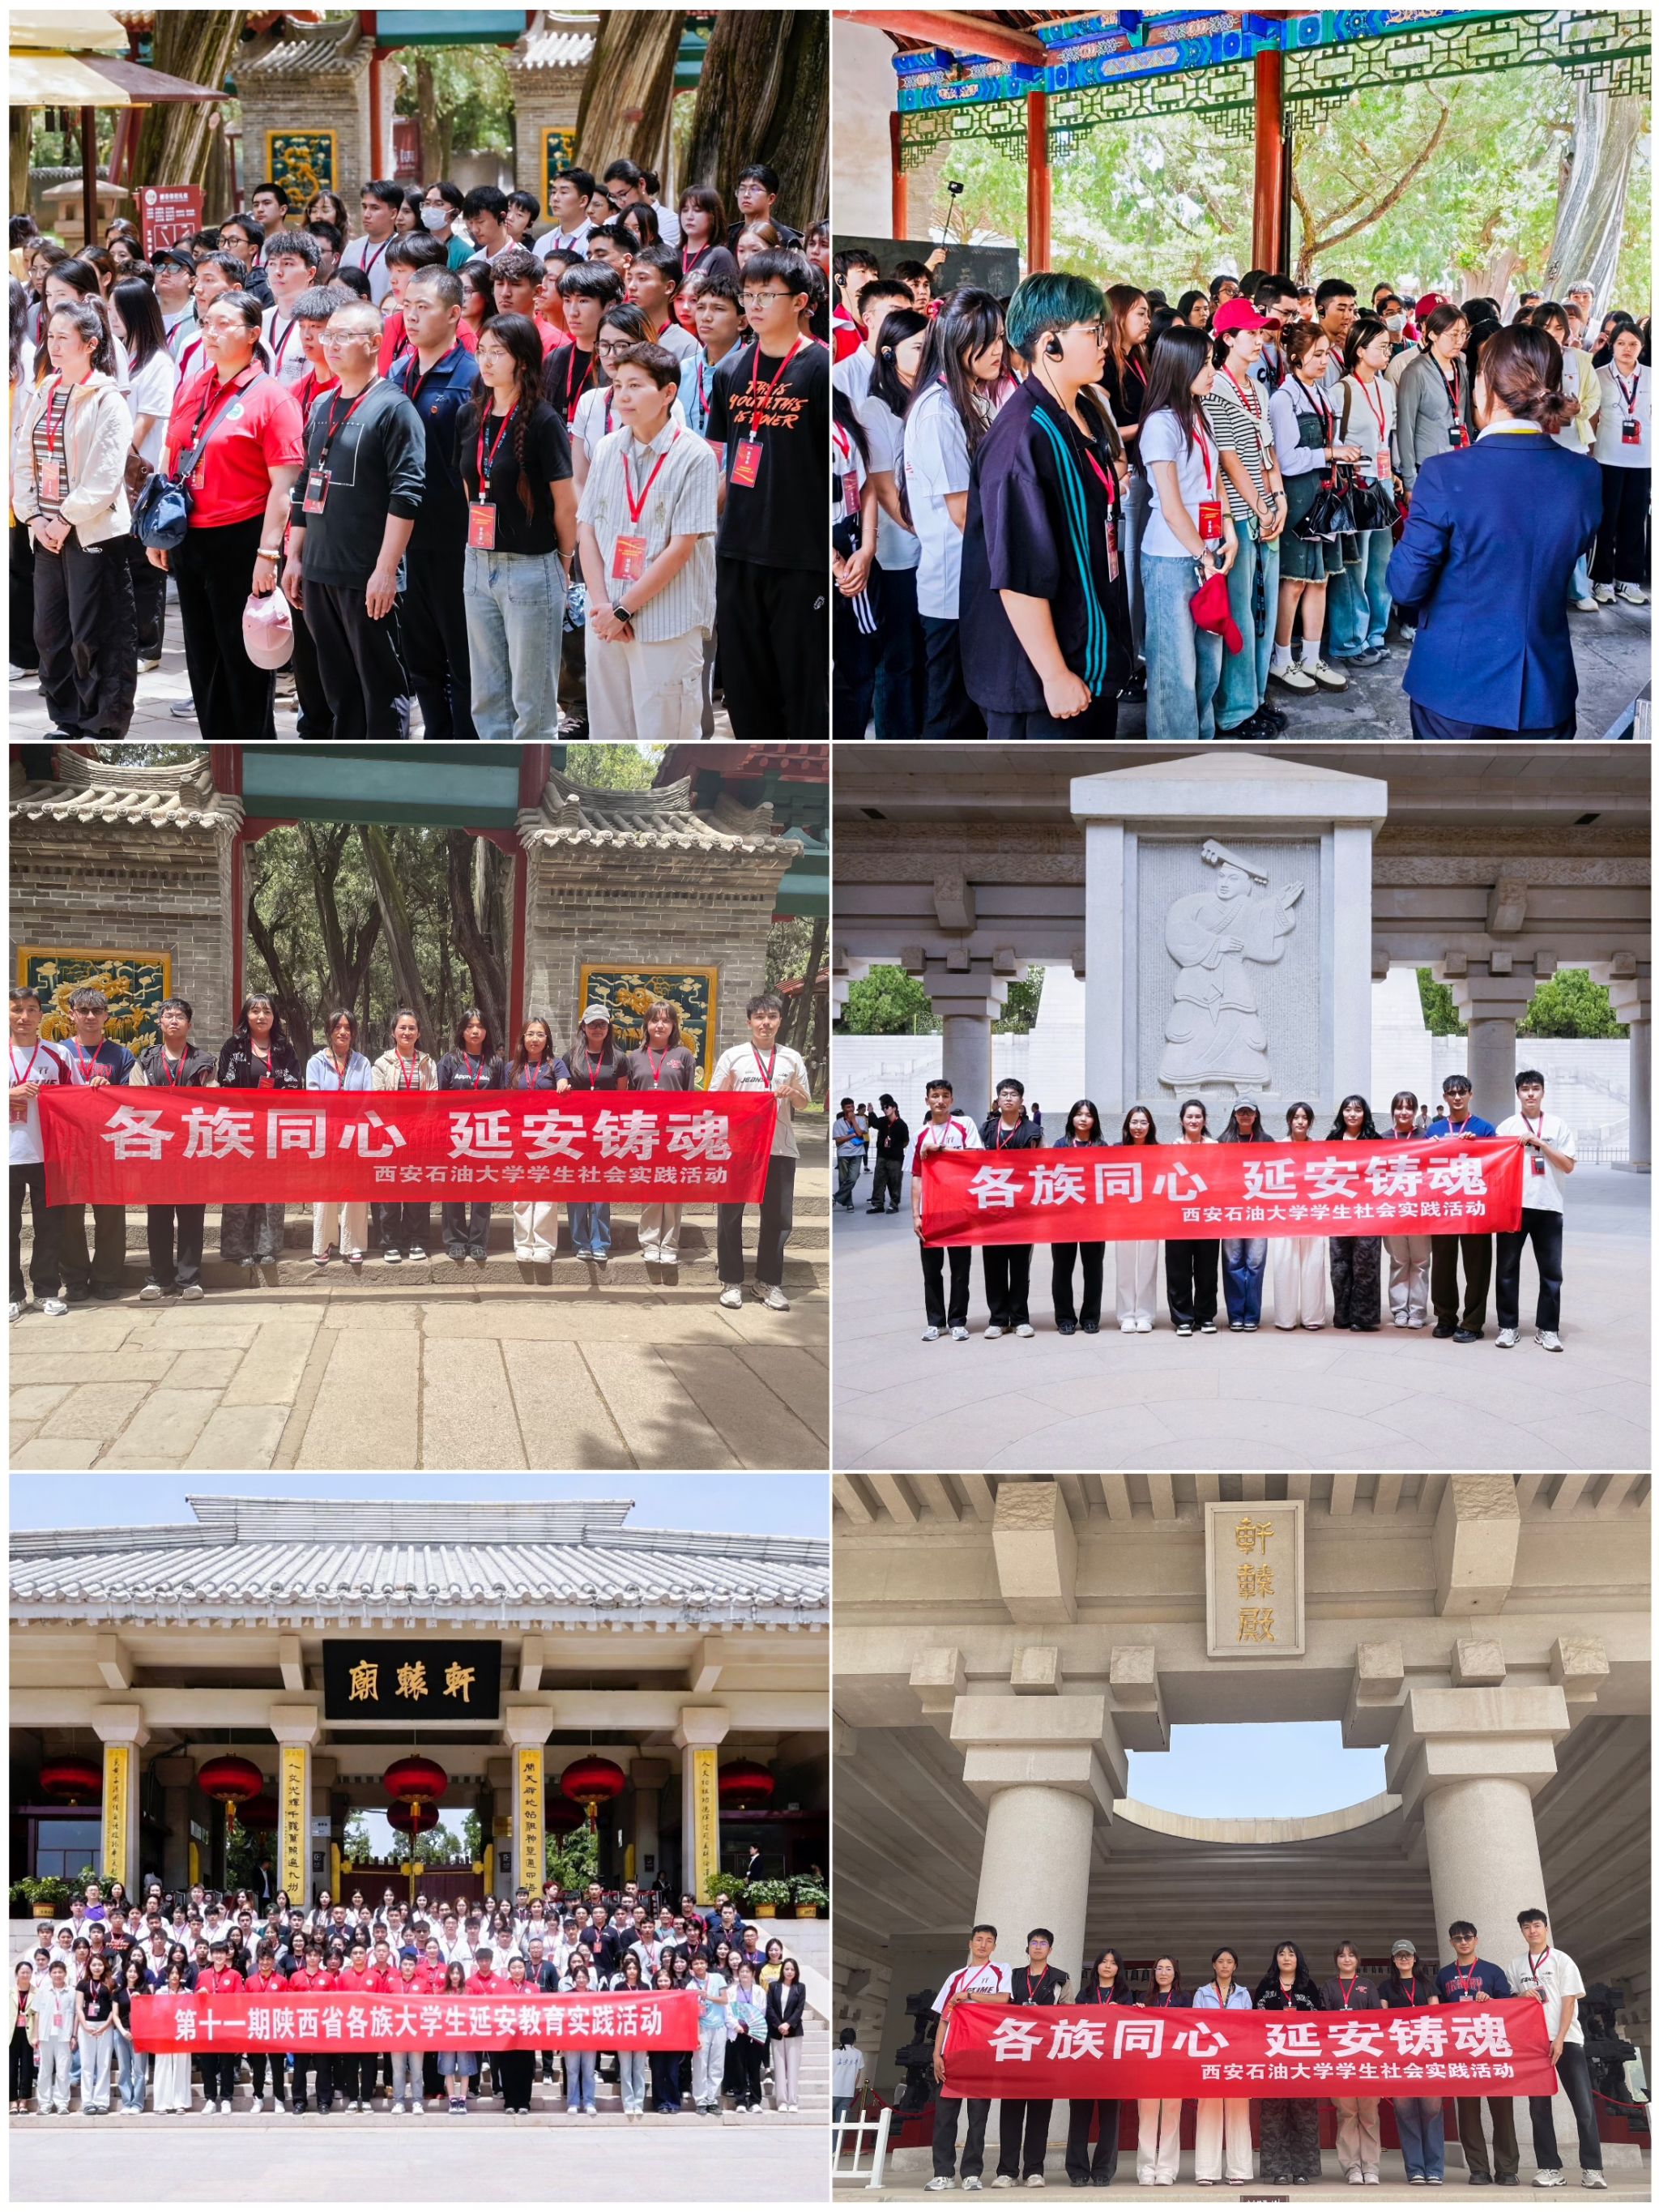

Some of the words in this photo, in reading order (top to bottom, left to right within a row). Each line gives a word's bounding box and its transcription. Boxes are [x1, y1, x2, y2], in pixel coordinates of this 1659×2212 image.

[772, 382, 792, 395] IS
[733, 410, 750, 422] IS
[101, 1105, 407, 1160] 各族同心
[448, 1108, 732, 1161] 延安铸魂
[374, 1165, 728, 1184] 西安石油大学学生社会实践活动
[968, 1161, 1209, 1210] 各族同心
[1242, 1152, 1489, 1201] 延安铸魂
[1182, 1199, 1486, 1223] 西安石油大学学生社会实践活动
[173, 2004, 663, 2042] 第十一期陕西省各族大学生延安教育实践活动
[987, 2017, 1230, 2062] 各族同心
[1265, 2013, 1514, 2058] 延安铸魂
[1201, 2062, 1515, 2082] 西安石油大学学生社会实践活动
